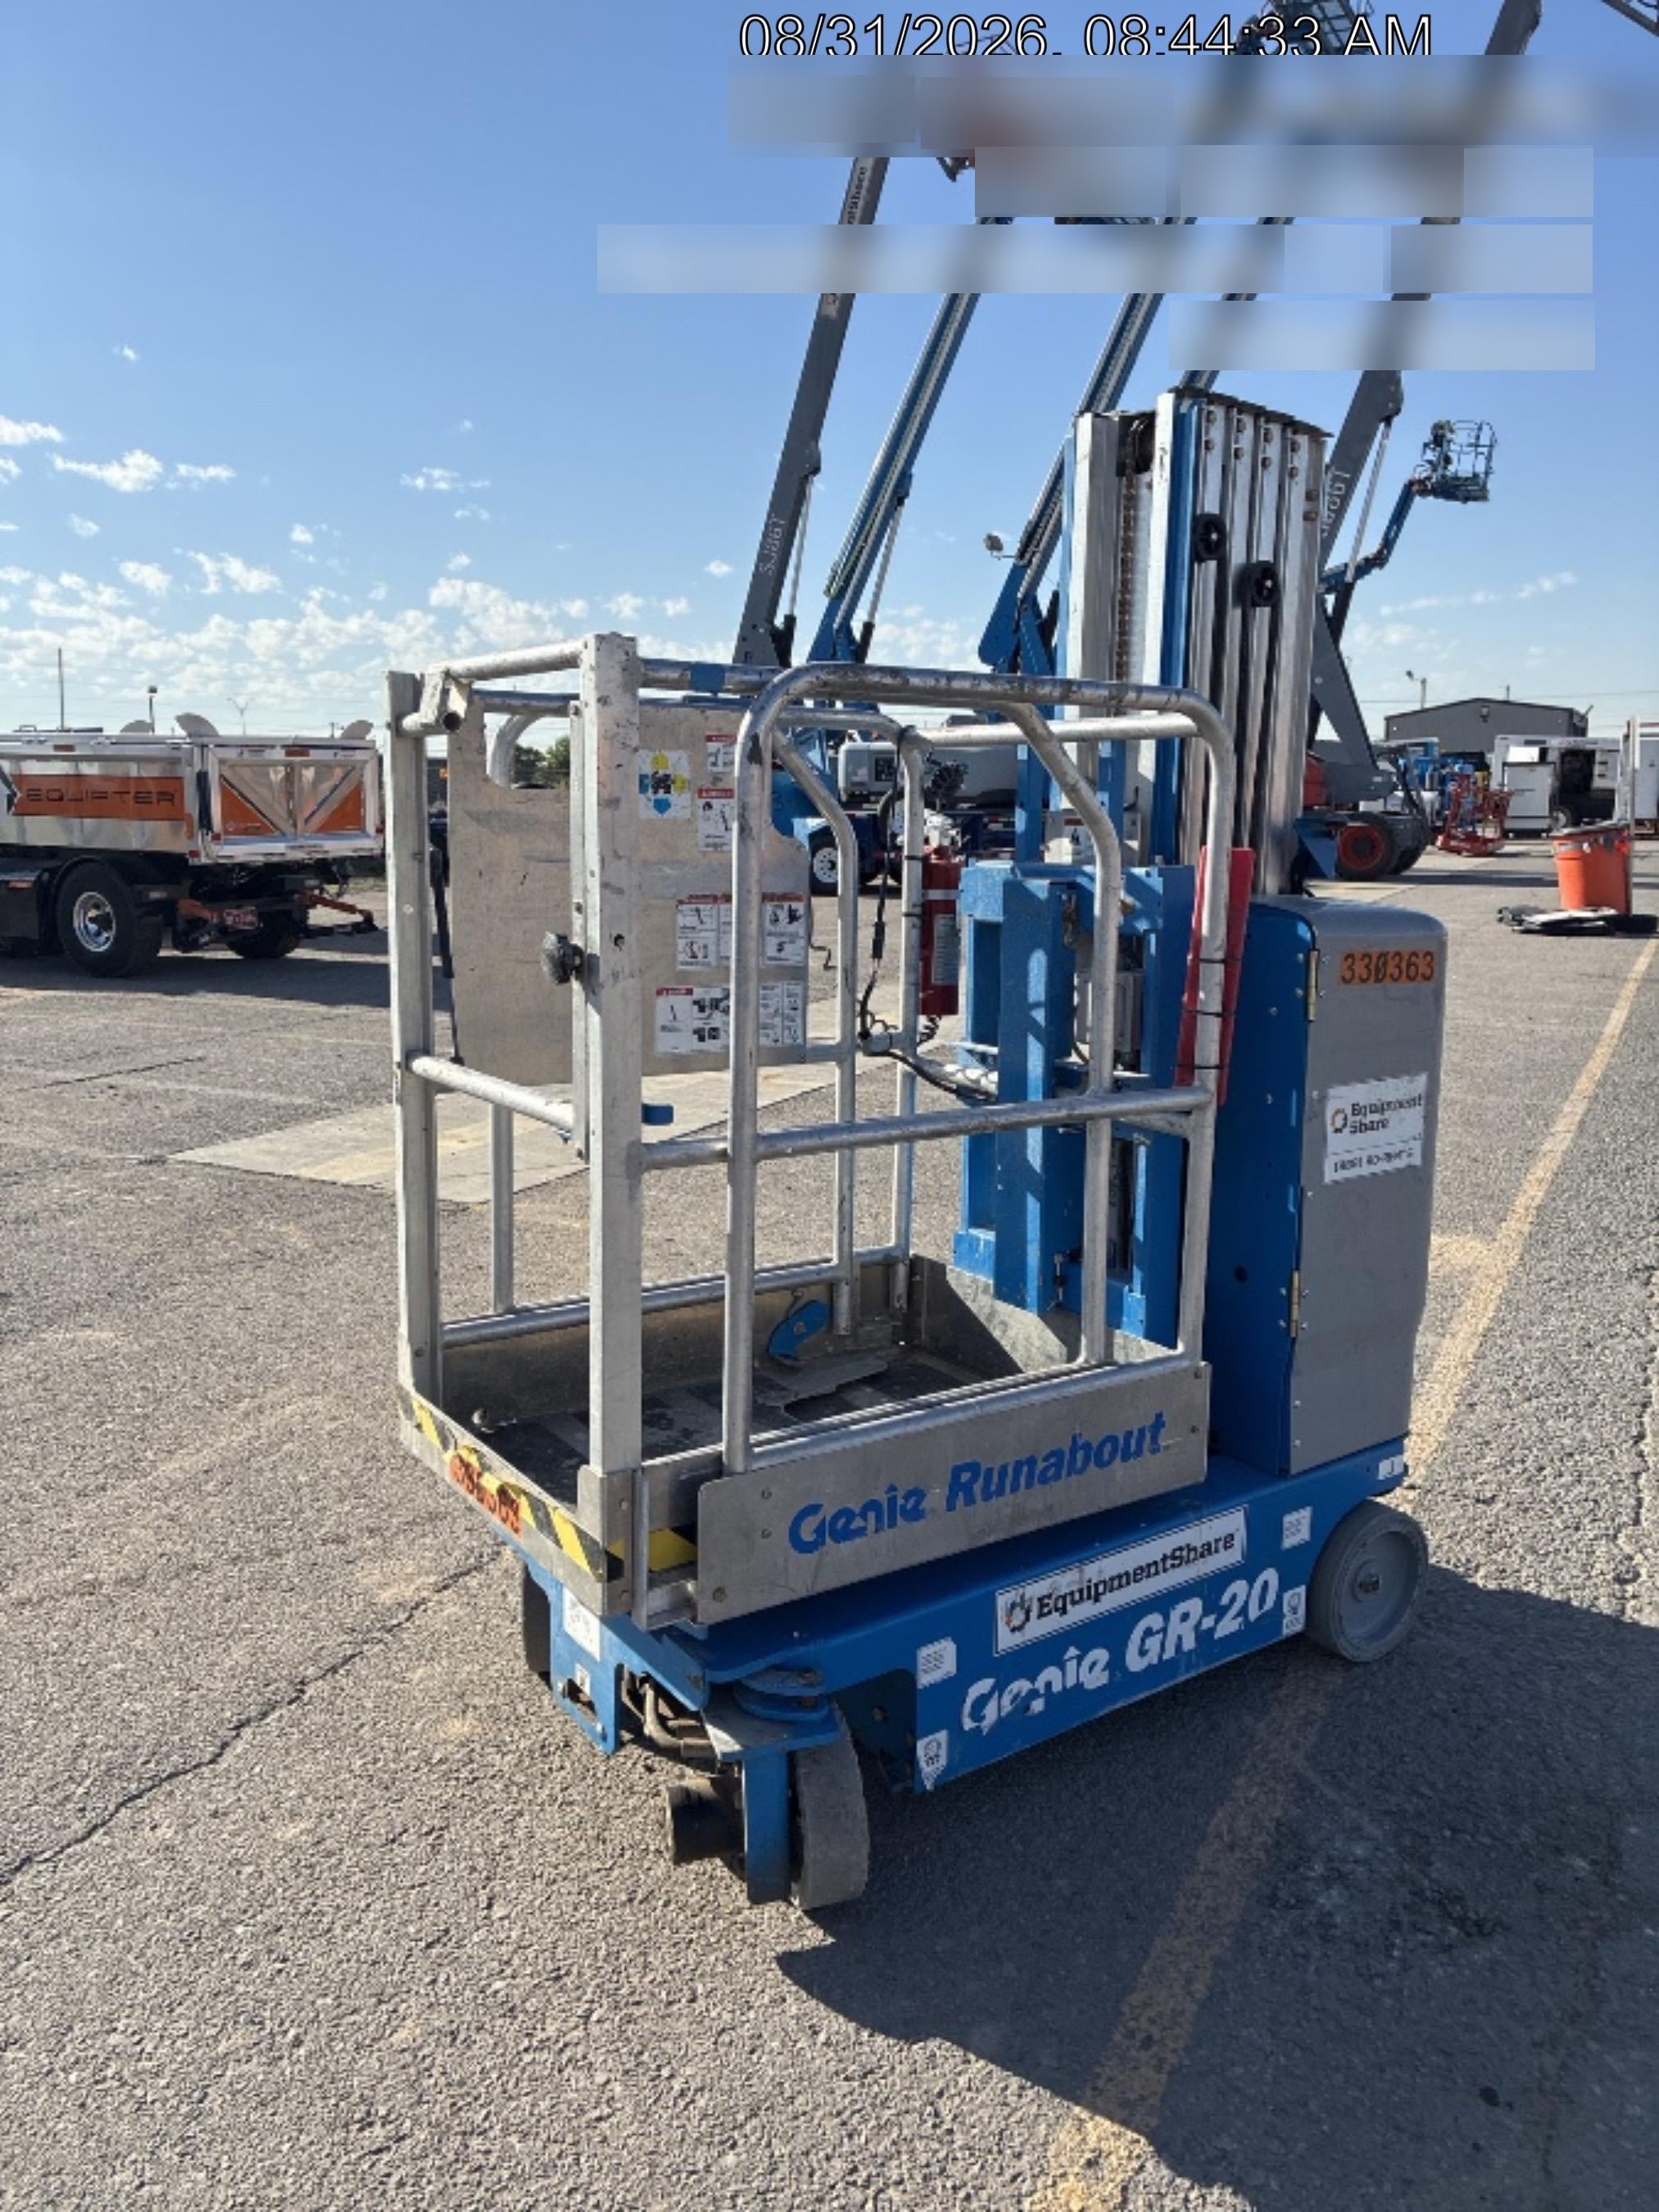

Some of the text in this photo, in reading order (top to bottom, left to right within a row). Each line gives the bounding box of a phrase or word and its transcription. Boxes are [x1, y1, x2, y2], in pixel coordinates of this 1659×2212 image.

[1341, 950, 1435, 984] 330363
[788, 1411, 1166, 1554] Genie Runabout
[1036, 1530, 1237, 1621] EquipmentShare
[962, 1567, 1280, 1735] Genie GR-20
